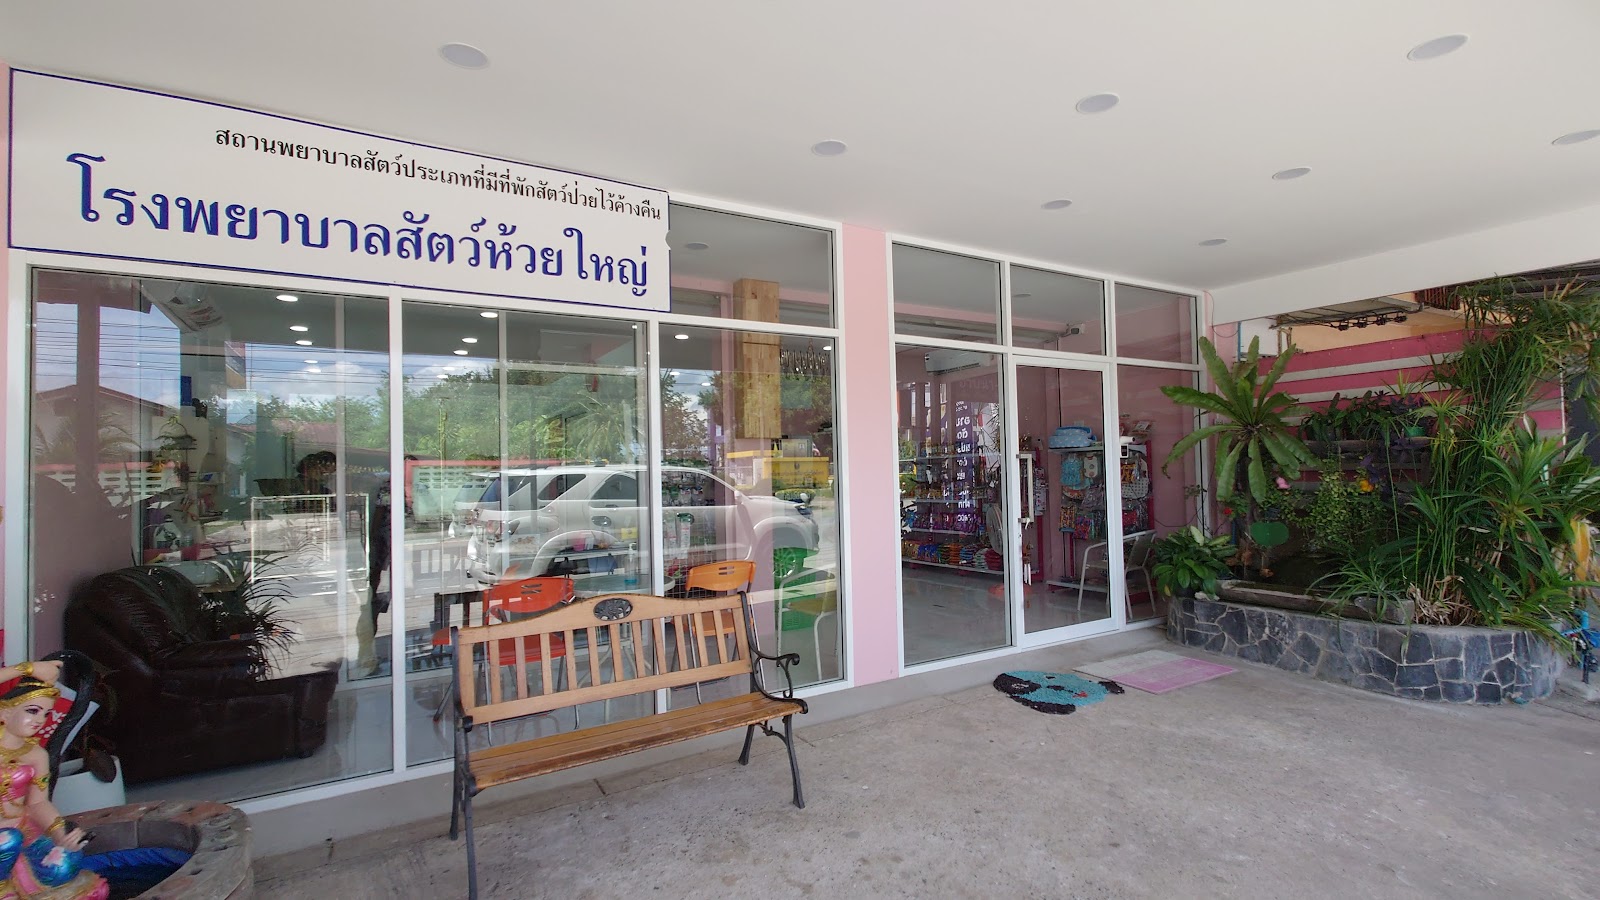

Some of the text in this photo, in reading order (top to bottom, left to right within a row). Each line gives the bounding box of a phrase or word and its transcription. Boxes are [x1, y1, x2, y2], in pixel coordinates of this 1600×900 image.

[65, 152, 648, 297] โรงพยาบาลสัตว์ห้วยใหญ่
[215, 129, 661, 220] สถานพยาบาลสัตว์ประเภทที่มีที่พักสัตว์ป่วยไว้ค้างคืน
